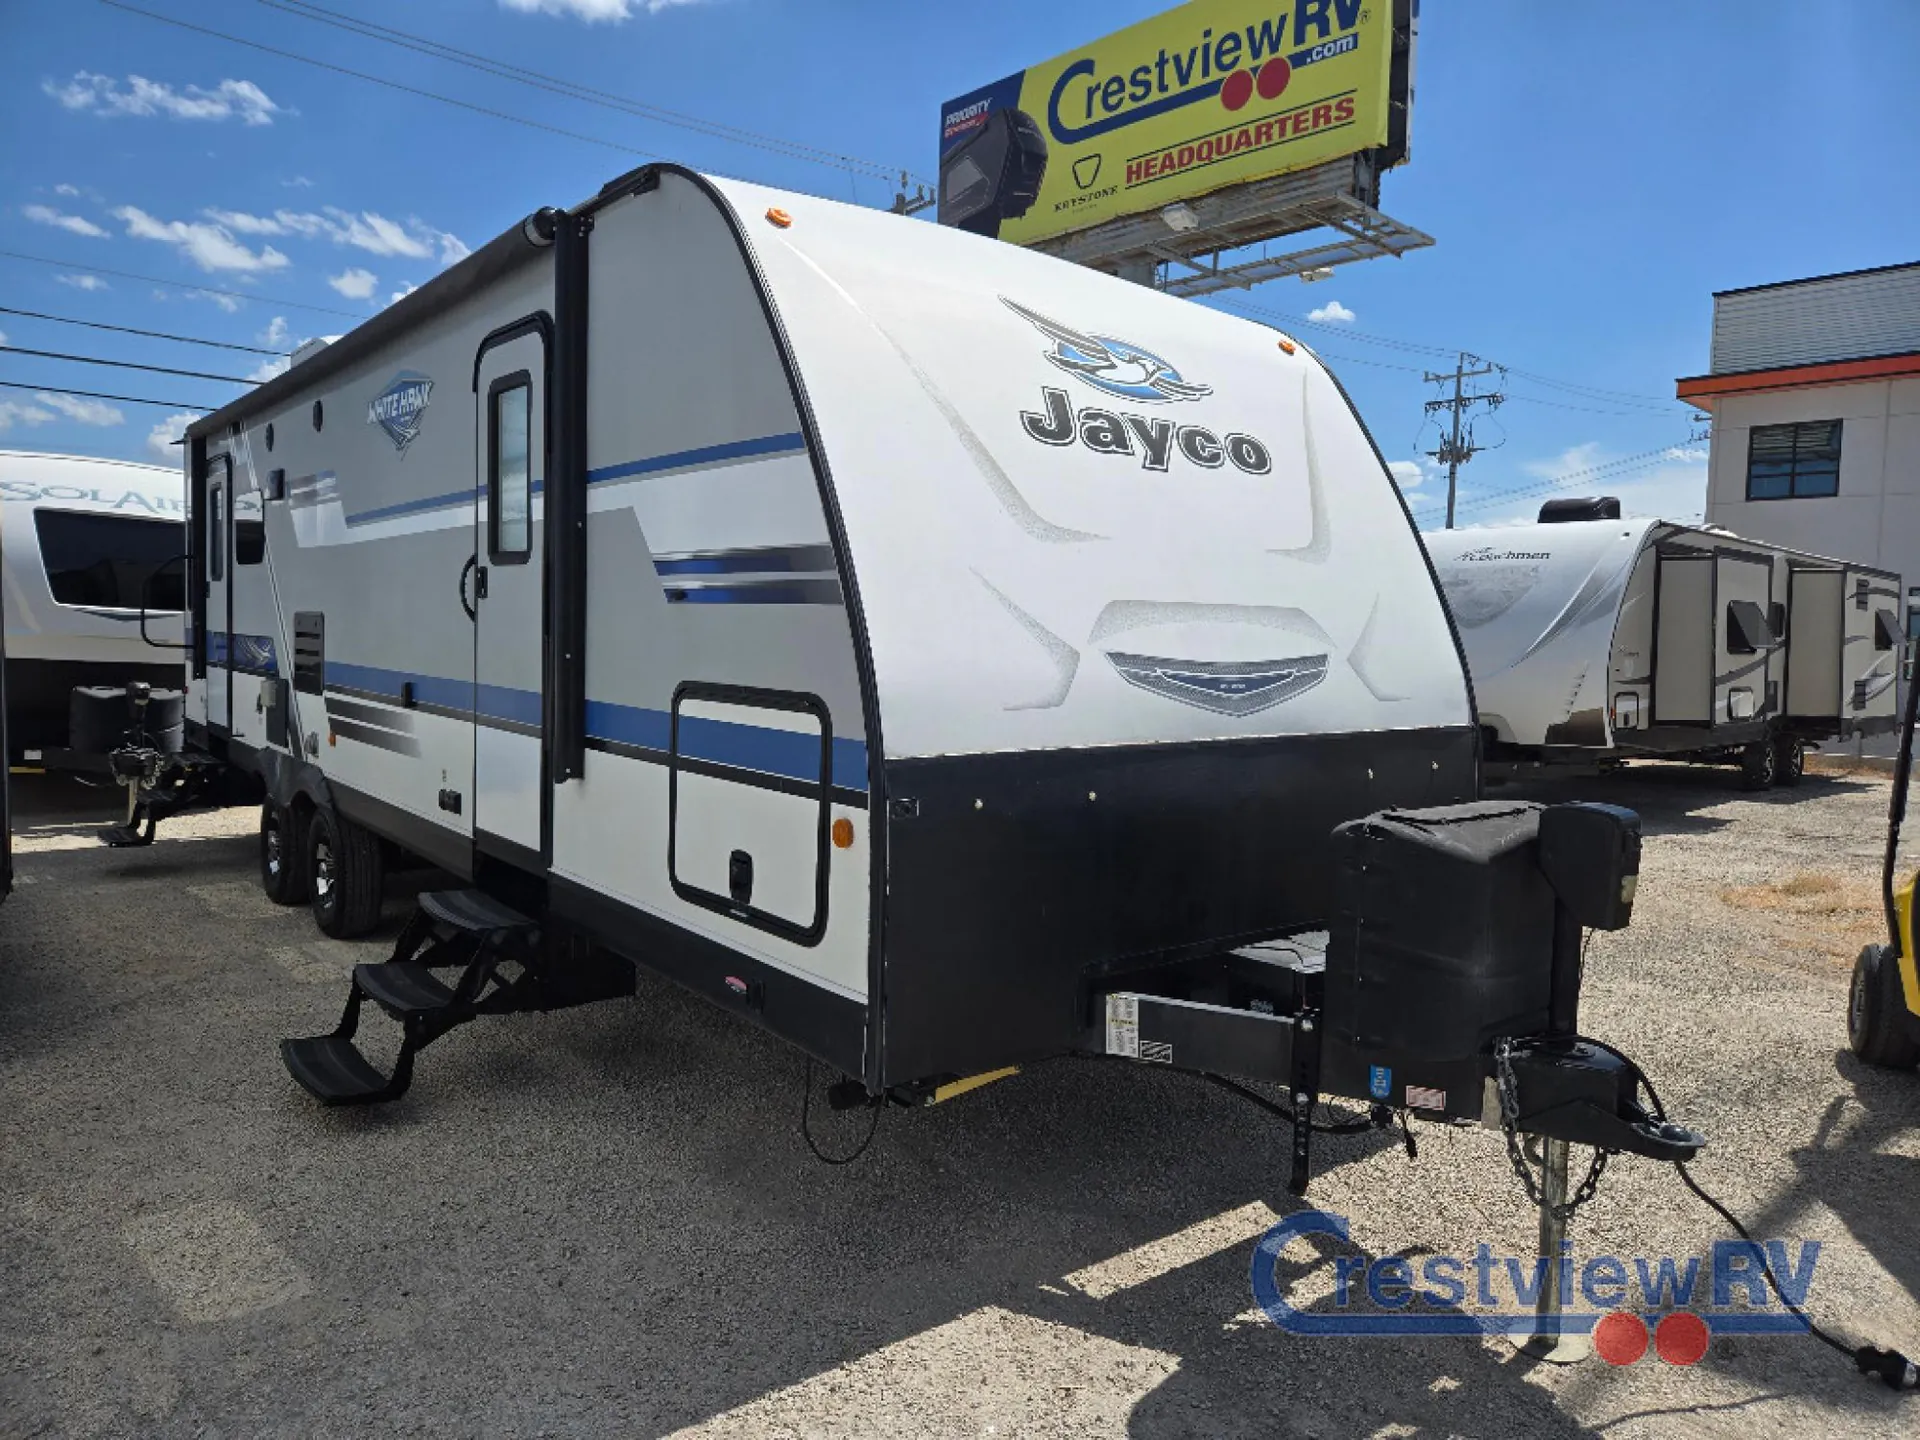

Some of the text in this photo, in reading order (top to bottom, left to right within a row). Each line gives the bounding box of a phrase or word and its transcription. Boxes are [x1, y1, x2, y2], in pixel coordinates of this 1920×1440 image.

[1306, 35, 1355, 63] .com
[1126, 97, 1355, 184] HEADQUARTERS
[1054, 185, 1118, 213] KEYSTONE
[1019, 386, 1272, 474] Jayco
